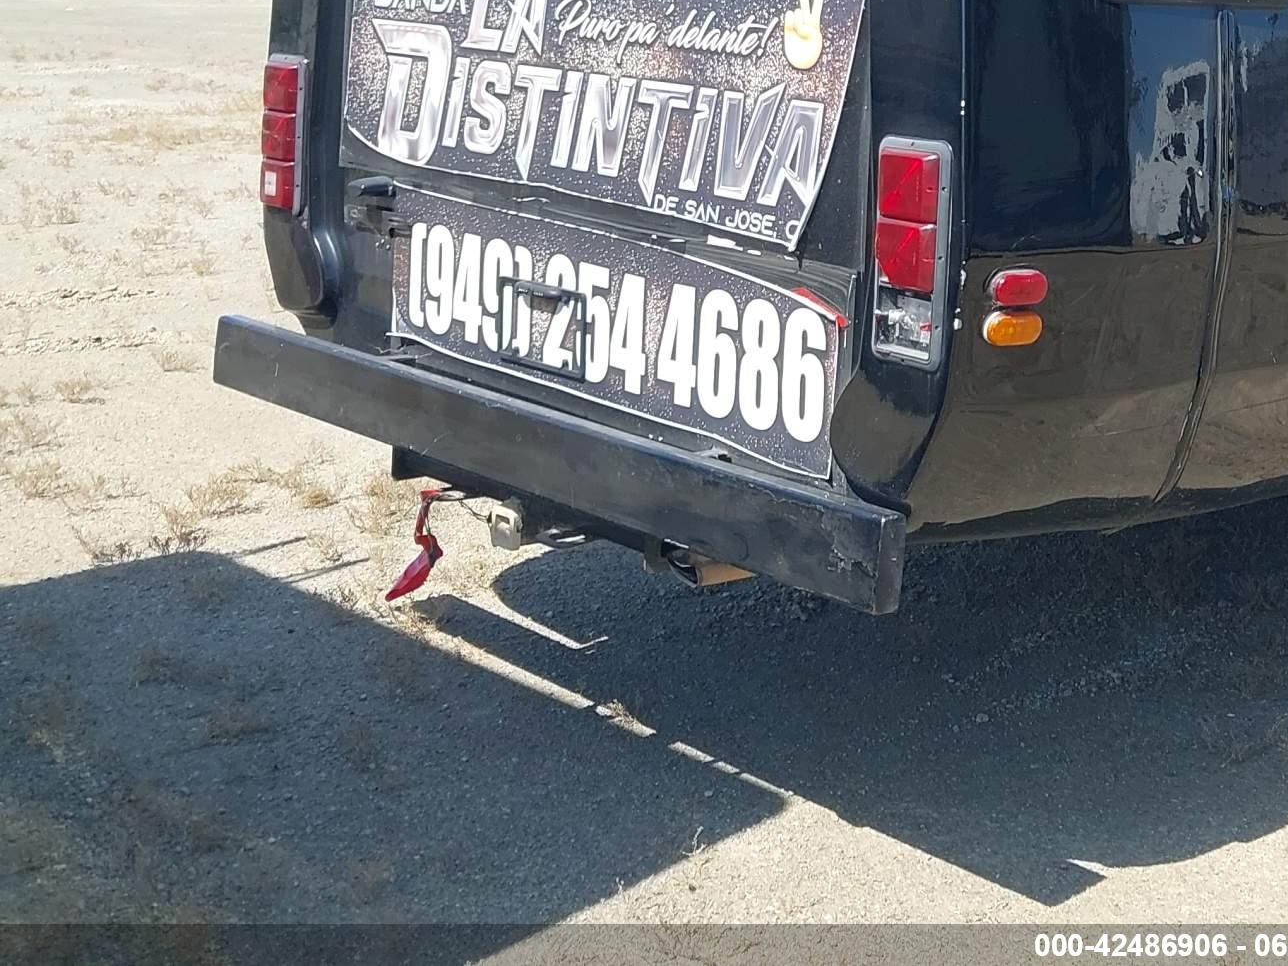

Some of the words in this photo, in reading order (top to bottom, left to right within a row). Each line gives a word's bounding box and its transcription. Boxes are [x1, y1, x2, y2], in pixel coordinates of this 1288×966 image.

[653, 194, 679, 214] DE
[684, 199, 721, 224] SAN
[542, 253, 646, 396] 254
[657, 283, 828, 443] 4686
